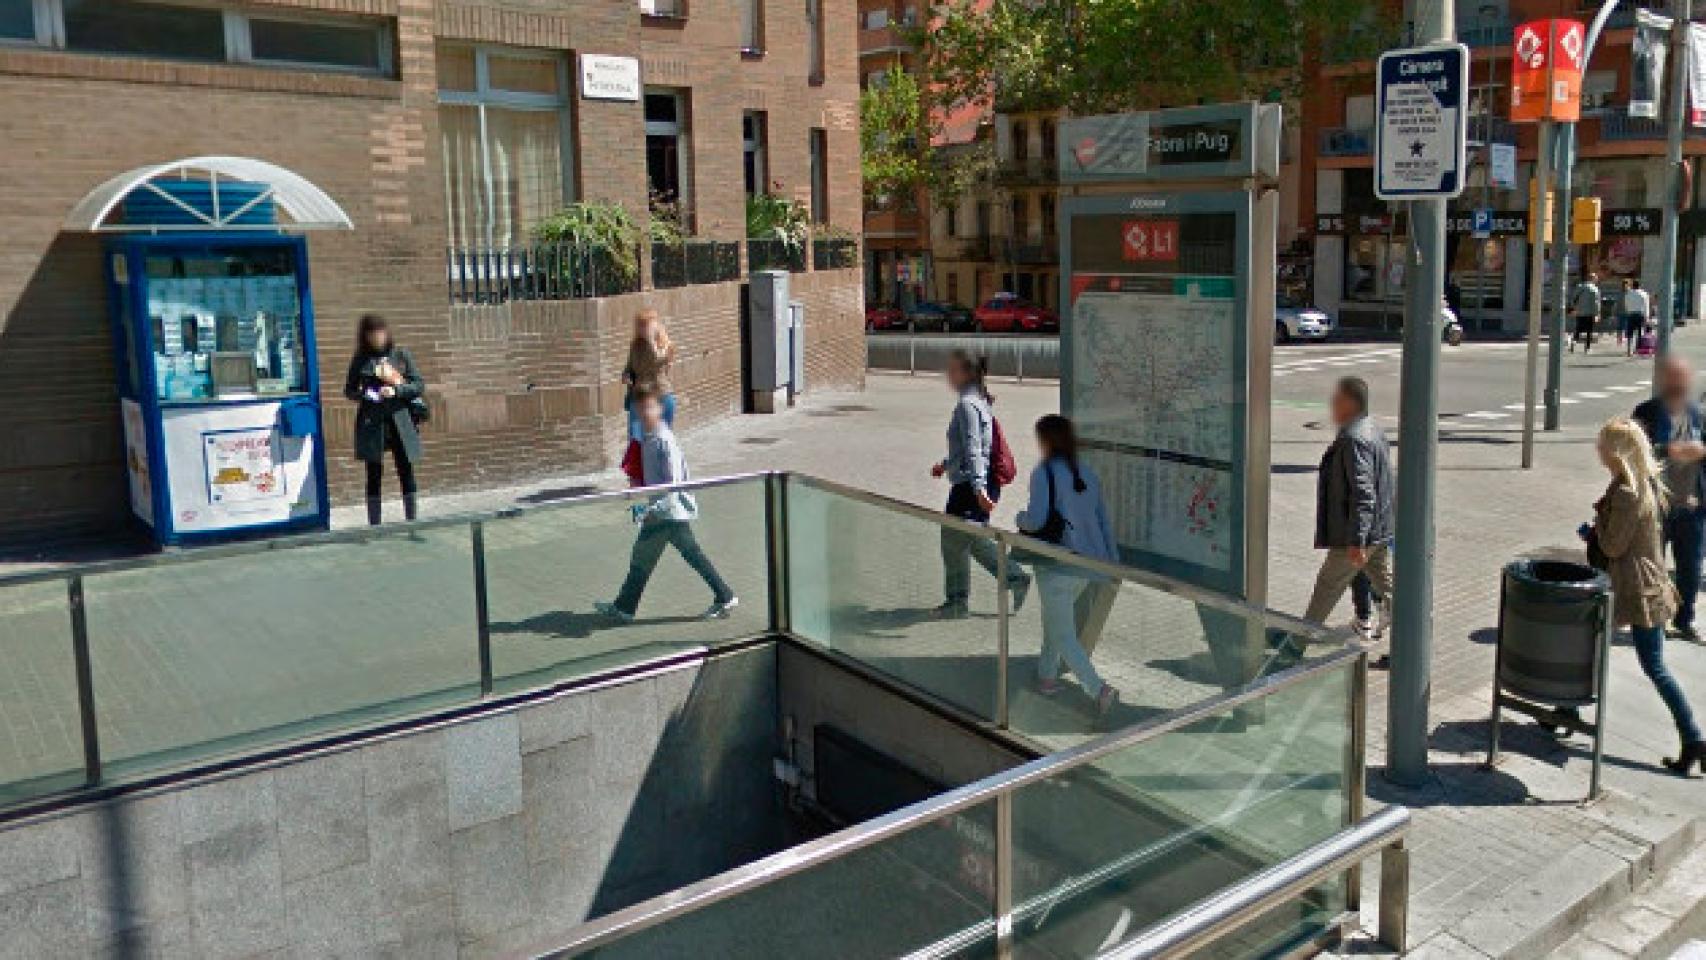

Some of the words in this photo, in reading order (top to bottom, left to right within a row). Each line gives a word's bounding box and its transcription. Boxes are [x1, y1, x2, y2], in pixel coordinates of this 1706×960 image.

[1147, 138, 1185, 153] Fabra
[1196, 131, 1230, 153] Puig
[1475, 213, 1488, 230] P
[1613, 215, 1631, 230] 50
[1153, 230, 1172, 253] L1
